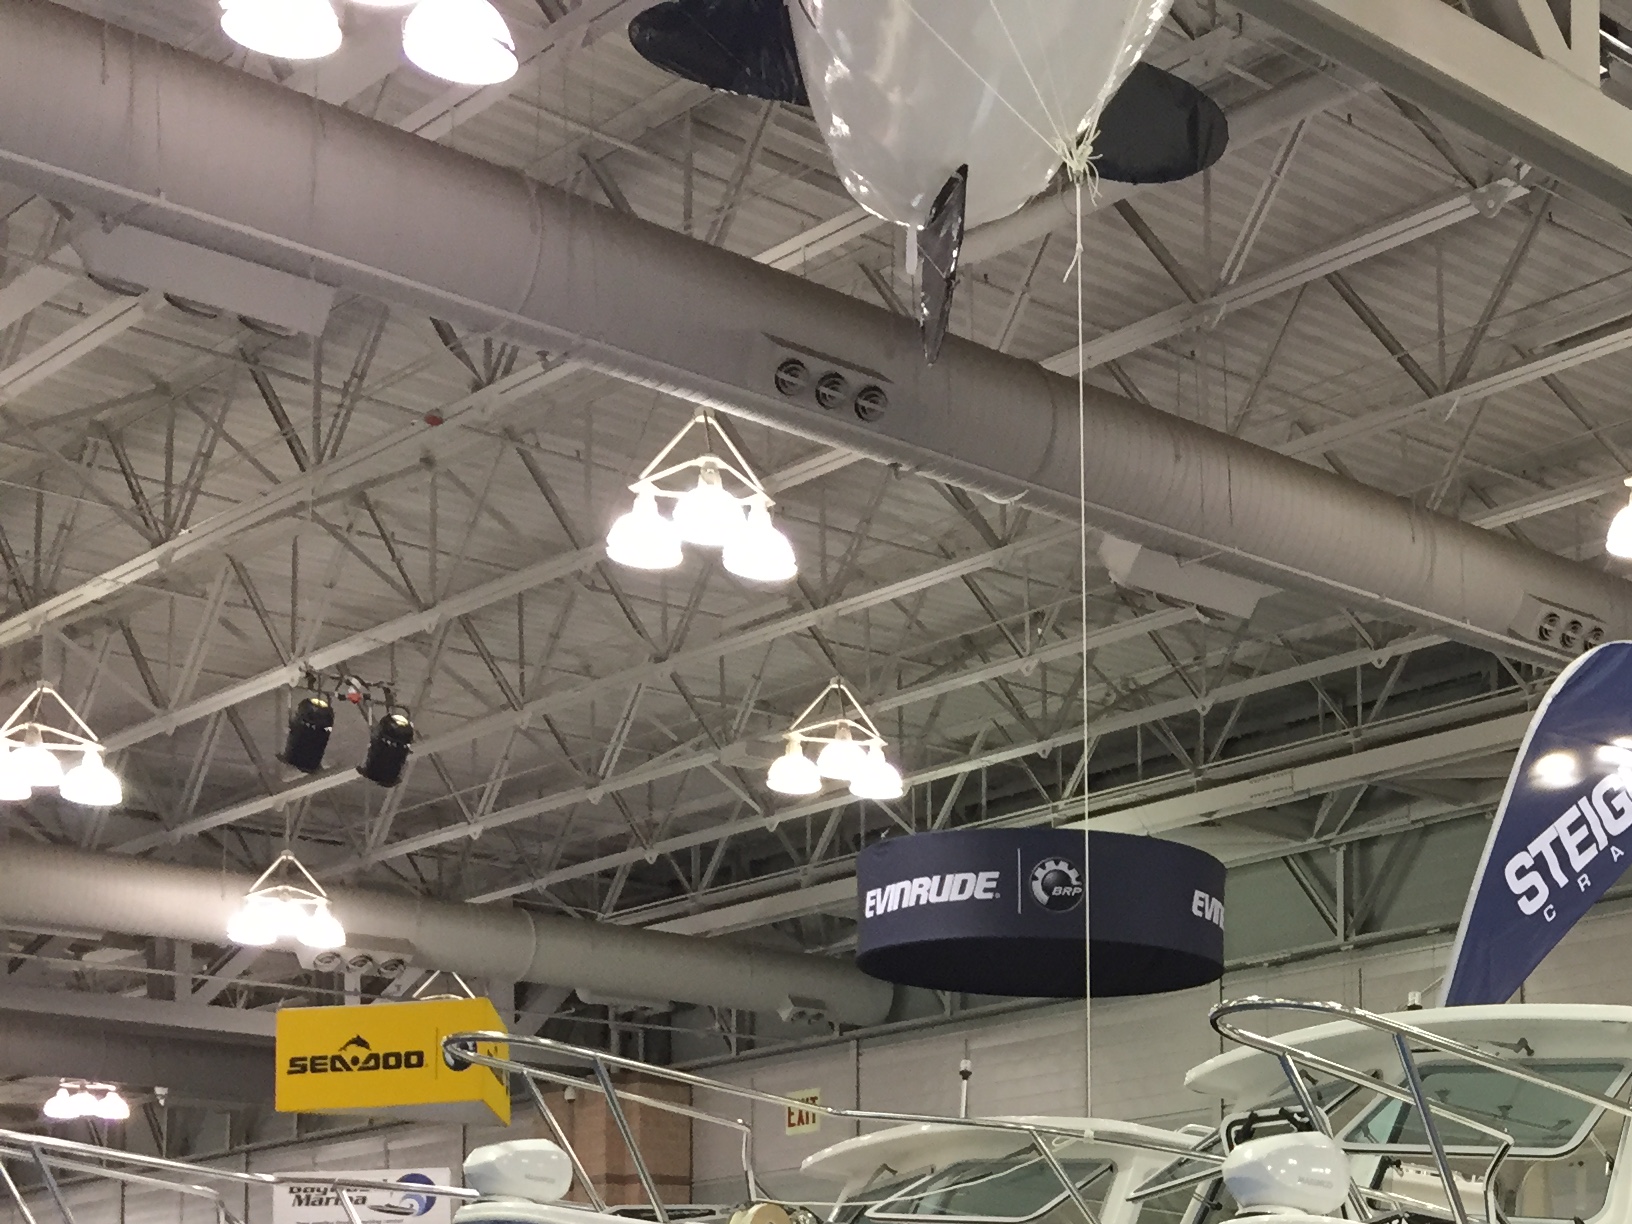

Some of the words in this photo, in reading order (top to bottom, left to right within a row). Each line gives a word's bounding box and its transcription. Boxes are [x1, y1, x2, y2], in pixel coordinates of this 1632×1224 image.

[865, 871, 1000, 919] EVINRUDE
[1052, 886, 1082, 896] BRP
[787, 1096, 819, 1127] EXIT
